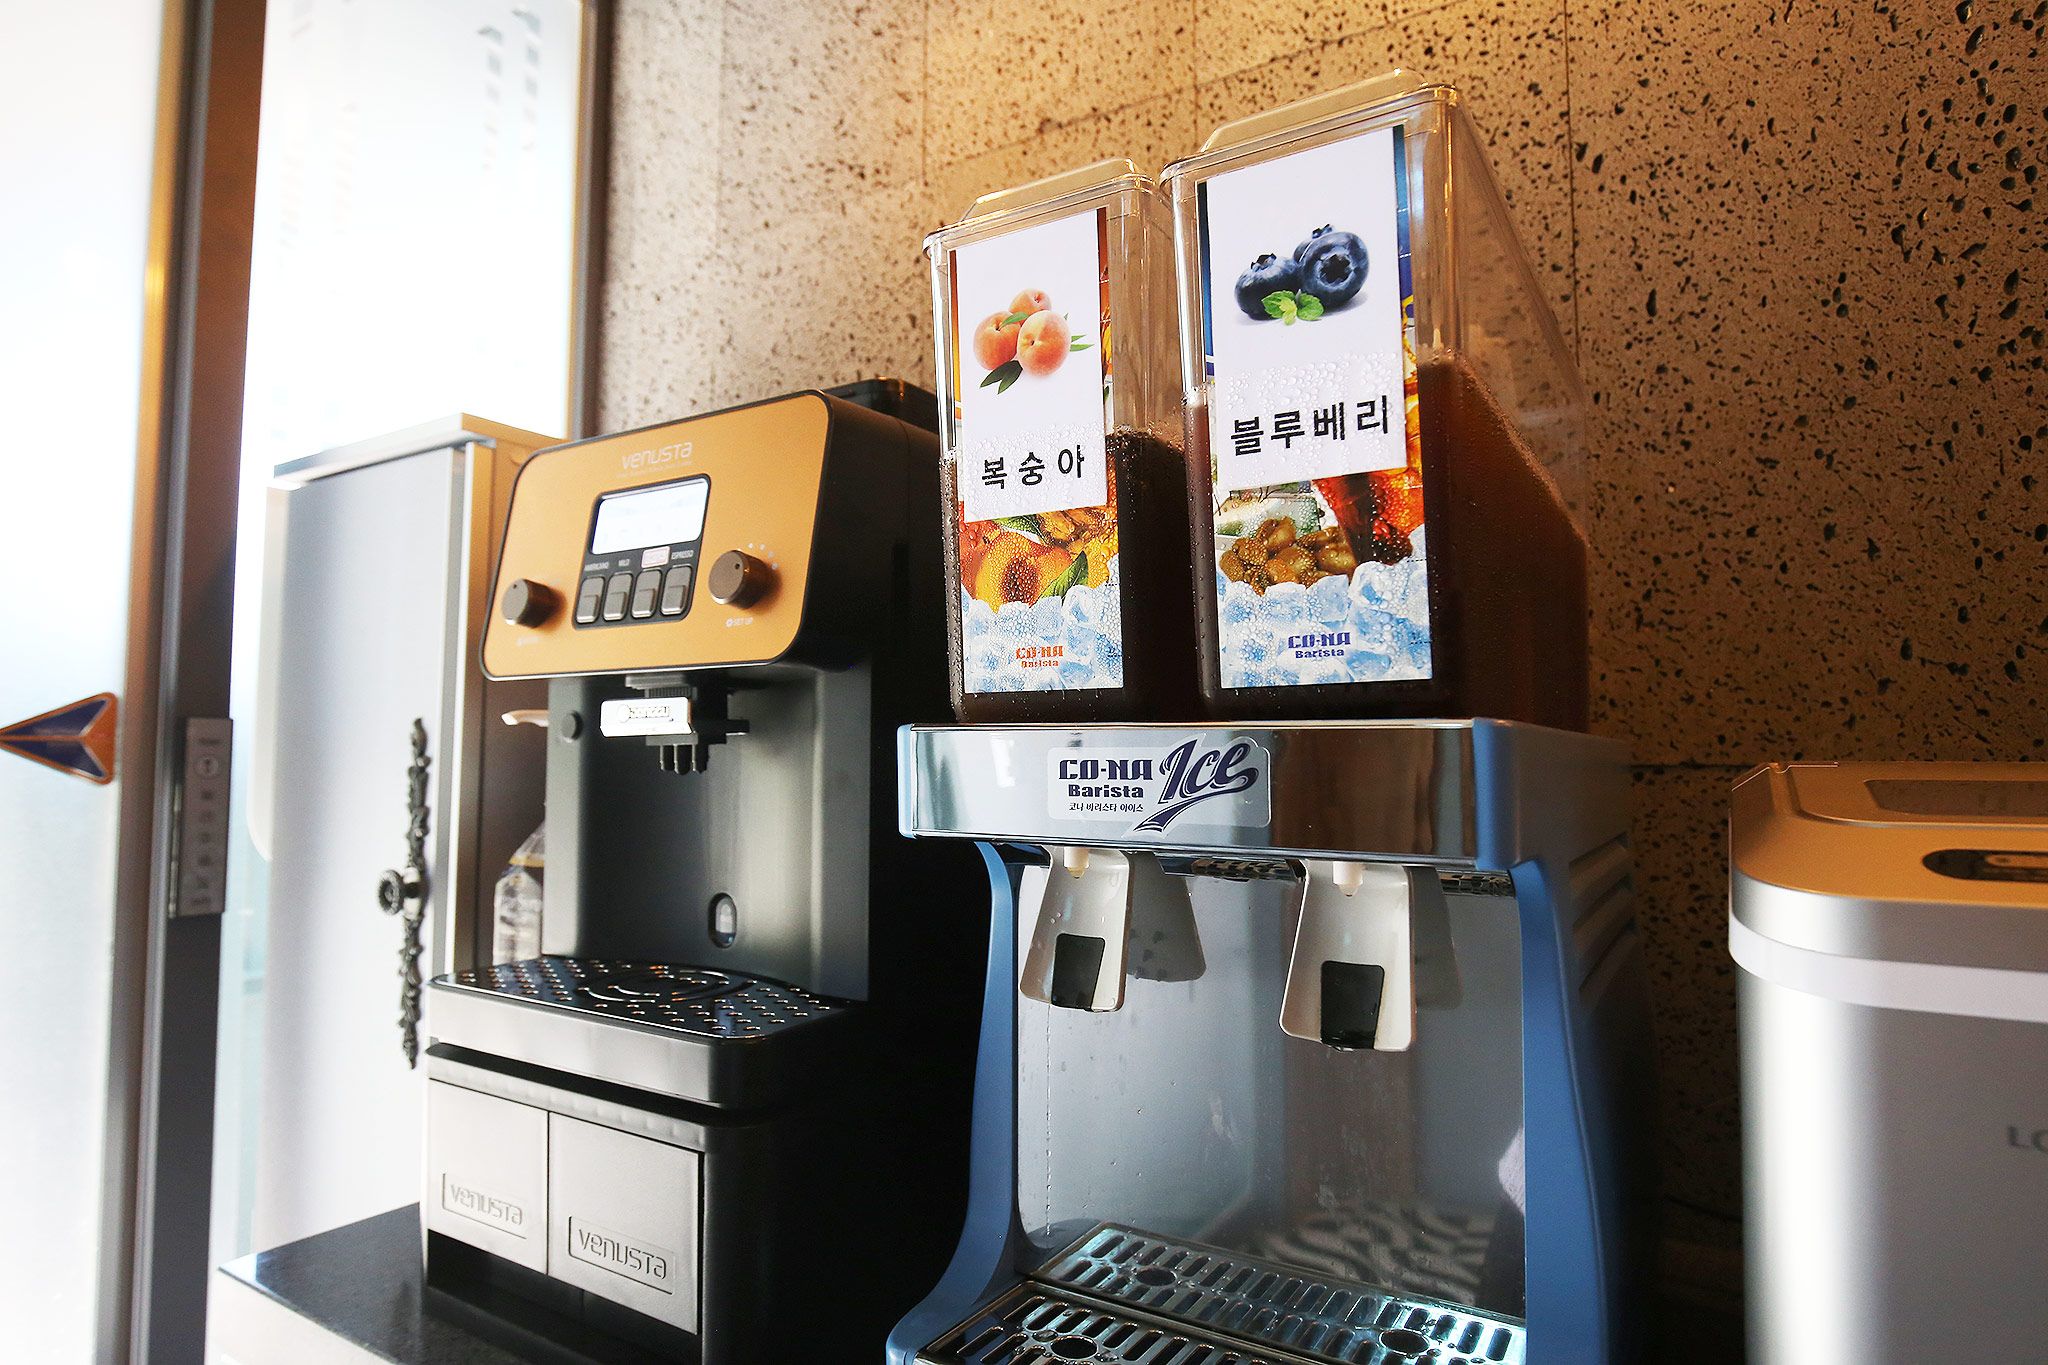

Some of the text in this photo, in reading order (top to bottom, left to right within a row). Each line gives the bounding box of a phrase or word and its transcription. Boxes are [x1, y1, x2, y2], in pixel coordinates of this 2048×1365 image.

[1230, 395, 1389, 457] 블루베리
[981, 444, 1085, 490] 복숭아
[1288, 632, 1351, 649] CO-NA
[1016, 645, 1064, 660] CO-NA
[1295, 648, 1345, 659] Barista
[1021, 660, 1059, 668] Barista
[1059, 759, 1154, 780] CO-NA
[1068, 784, 1144, 798] Barista
[1133, 738, 1260, 833] Ice
